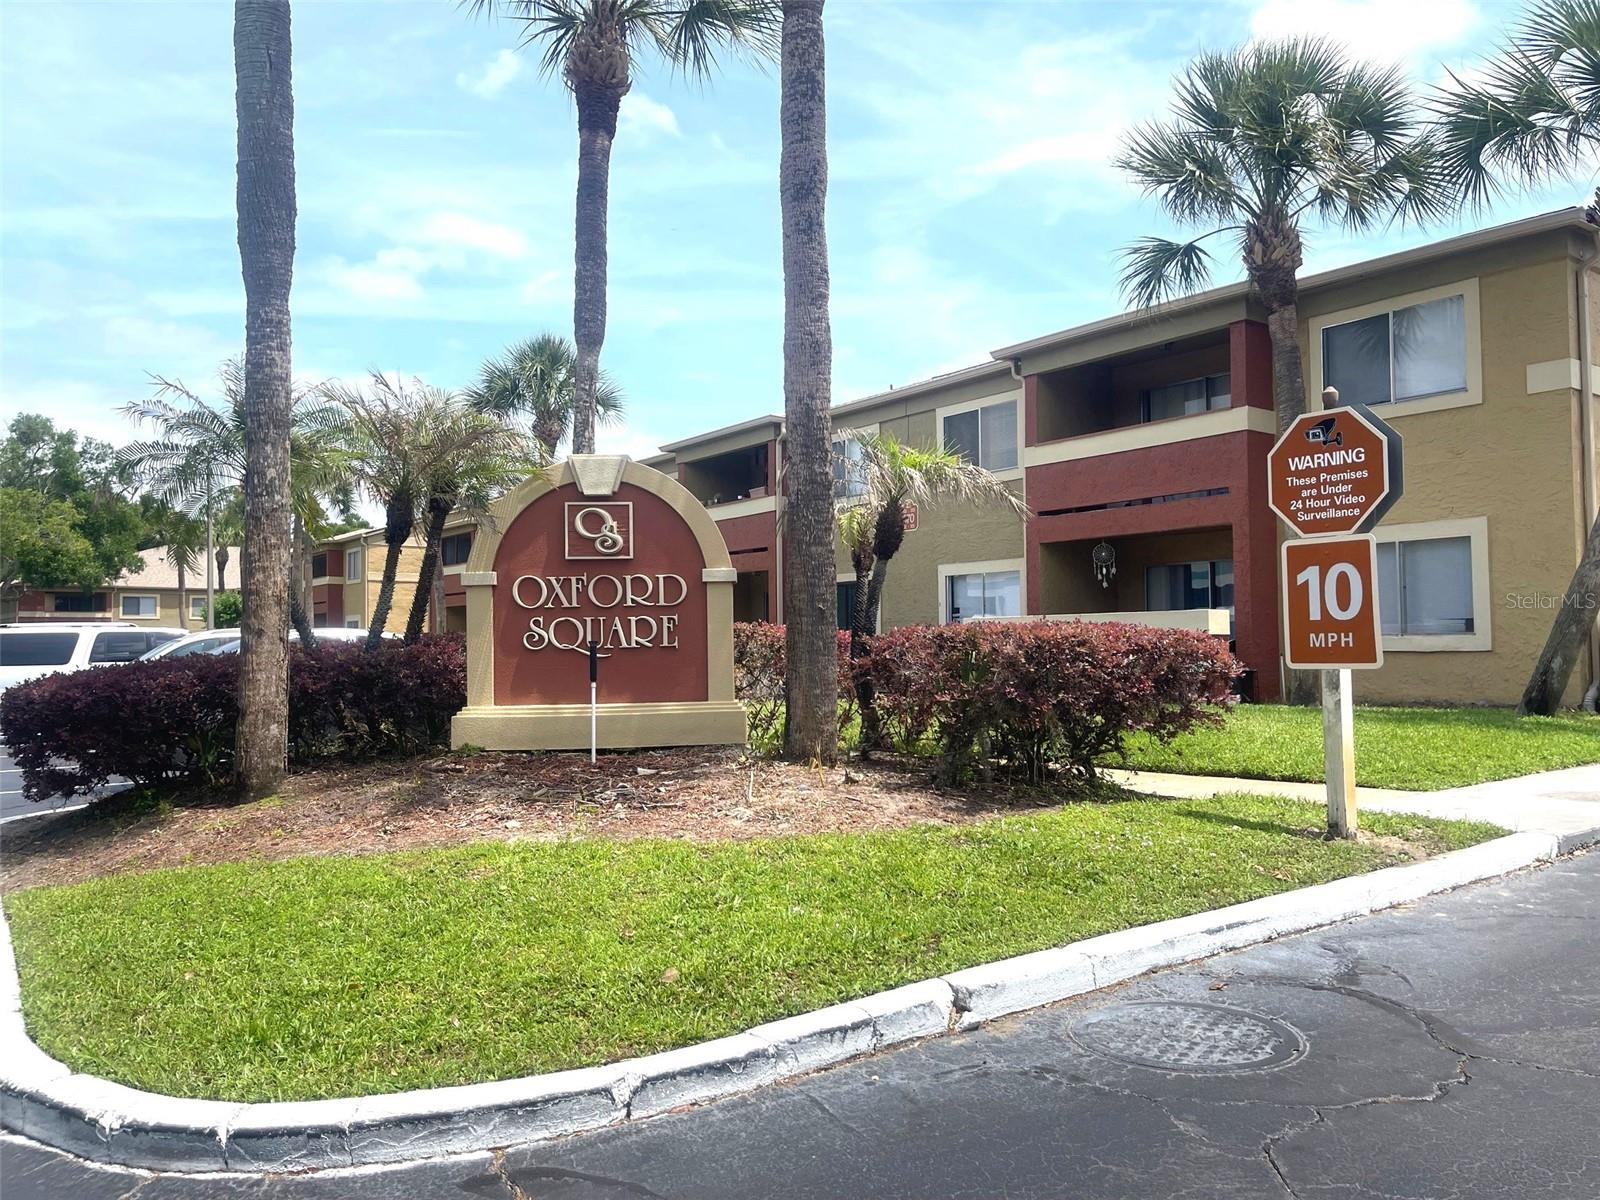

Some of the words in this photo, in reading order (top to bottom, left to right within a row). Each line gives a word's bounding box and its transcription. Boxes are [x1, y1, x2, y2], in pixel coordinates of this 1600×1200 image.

[1288, 447, 1365, 471] WARNING
[1286, 476, 1317, 487] These
[1320, 469, 1369, 483] Premises
[1301, 488, 1317, 497] are
[1320, 483, 1352, 495] Under
[1290, 499, 1303, 510] 24
[1306, 498, 1331, 508] Hour
[1334, 494, 1366, 505] Video
[1297, 508, 1360, 521] Surveillance
[512, 572, 688, 609] OXFORD
[1295, 562, 1364, 622] 10
[522, 613, 679, 657] SQUARE
[1309, 631, 1354, 648] MPH
